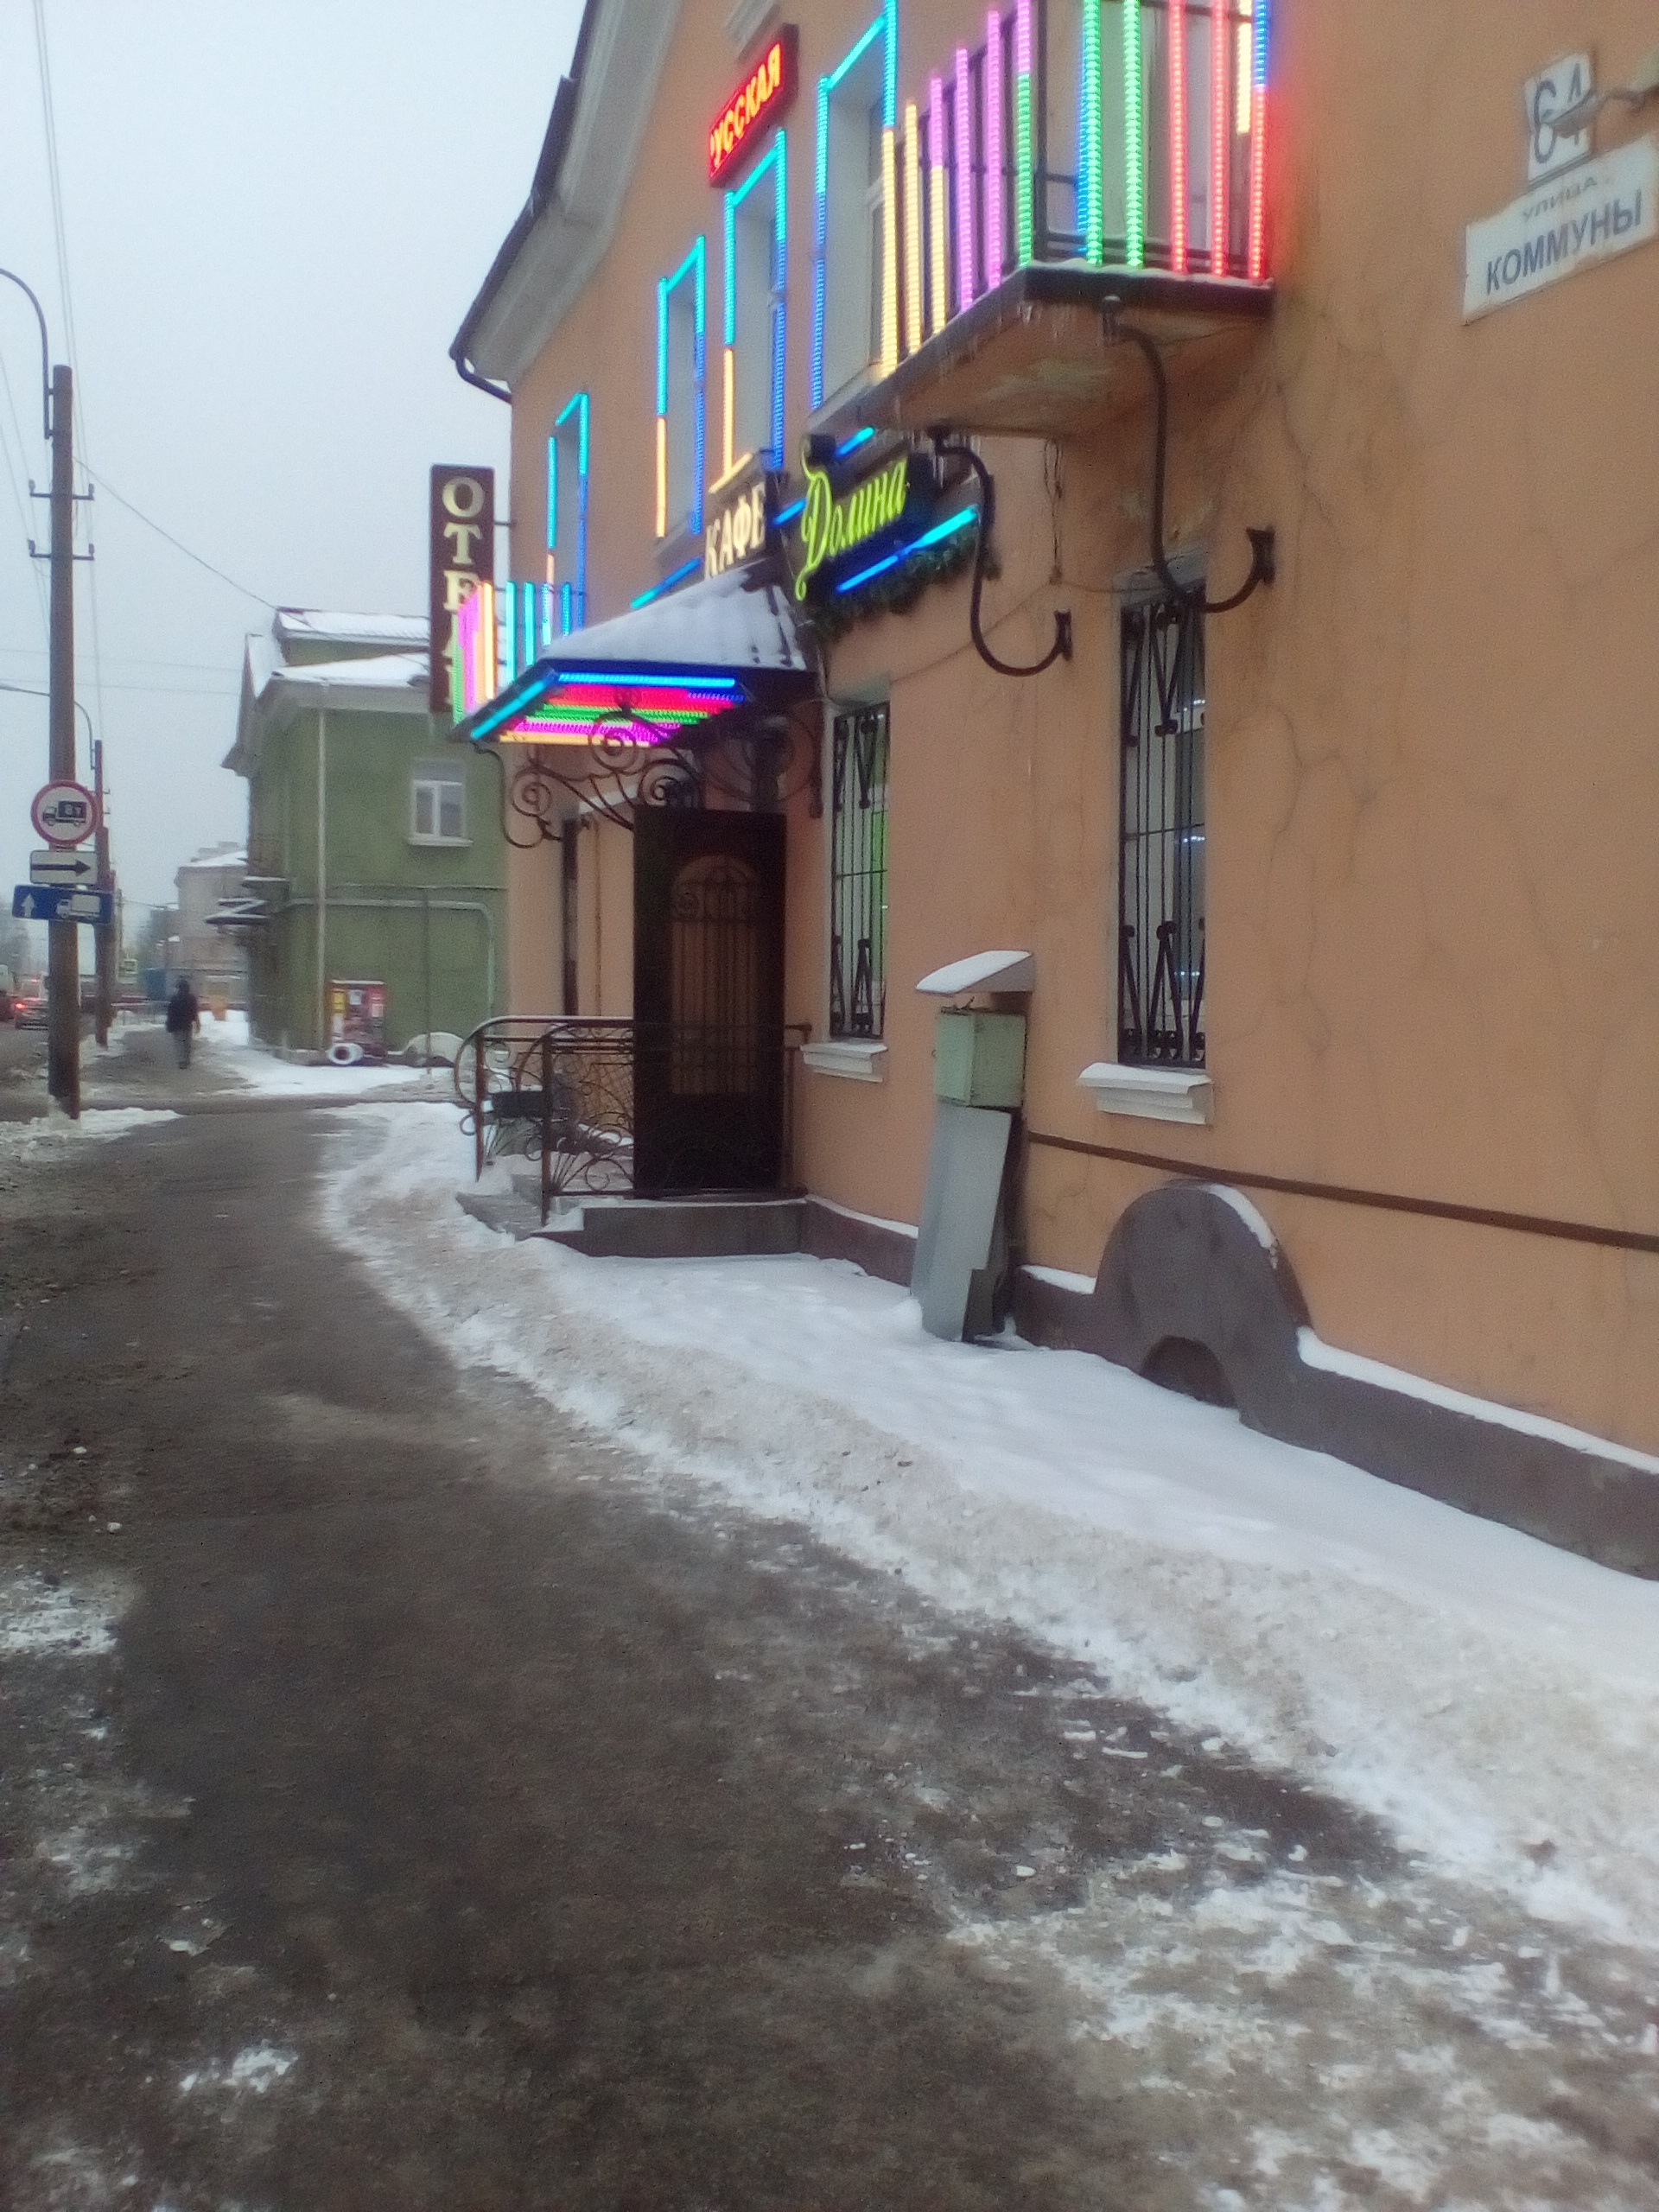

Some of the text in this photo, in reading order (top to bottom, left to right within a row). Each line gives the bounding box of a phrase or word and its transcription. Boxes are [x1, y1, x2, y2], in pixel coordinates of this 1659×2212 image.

[1486, 188, 1642, 296] КОММУНЫ
[704, 481, 766, 580] КАФЕ
[442, 477, 485, 707] ОТЕ
